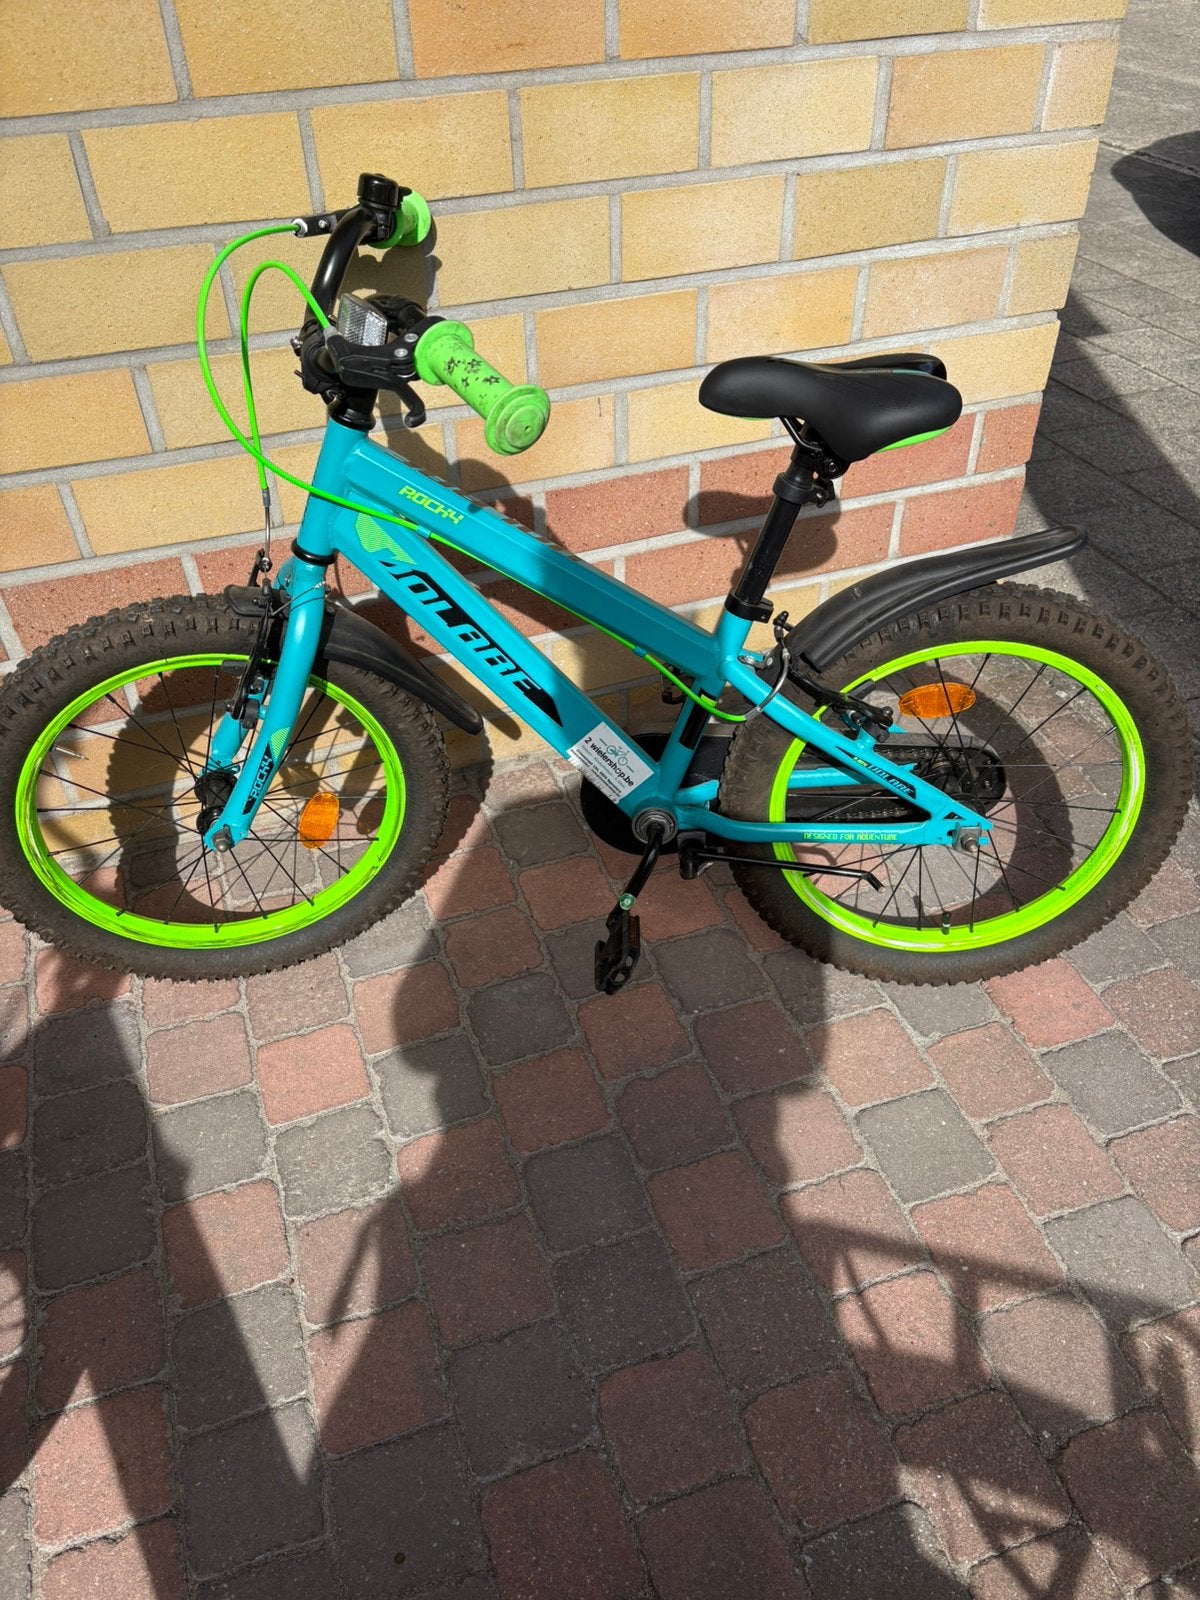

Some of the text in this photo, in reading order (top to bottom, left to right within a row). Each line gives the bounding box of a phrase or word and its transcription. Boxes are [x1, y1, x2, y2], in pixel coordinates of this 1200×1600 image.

[398, 485, 464, 524] ROCKY
[378, 559, 546, 698] VOLARE
[250, 755, 273, 799] ROCKY
[584, 737, 593, 745] 2
[590, 742, 634, 787] wielershop.be
[868, 764, 914, 796] VOLARE
[803, 832, 898, 841] DESIGNED FOR ADVENTURE
